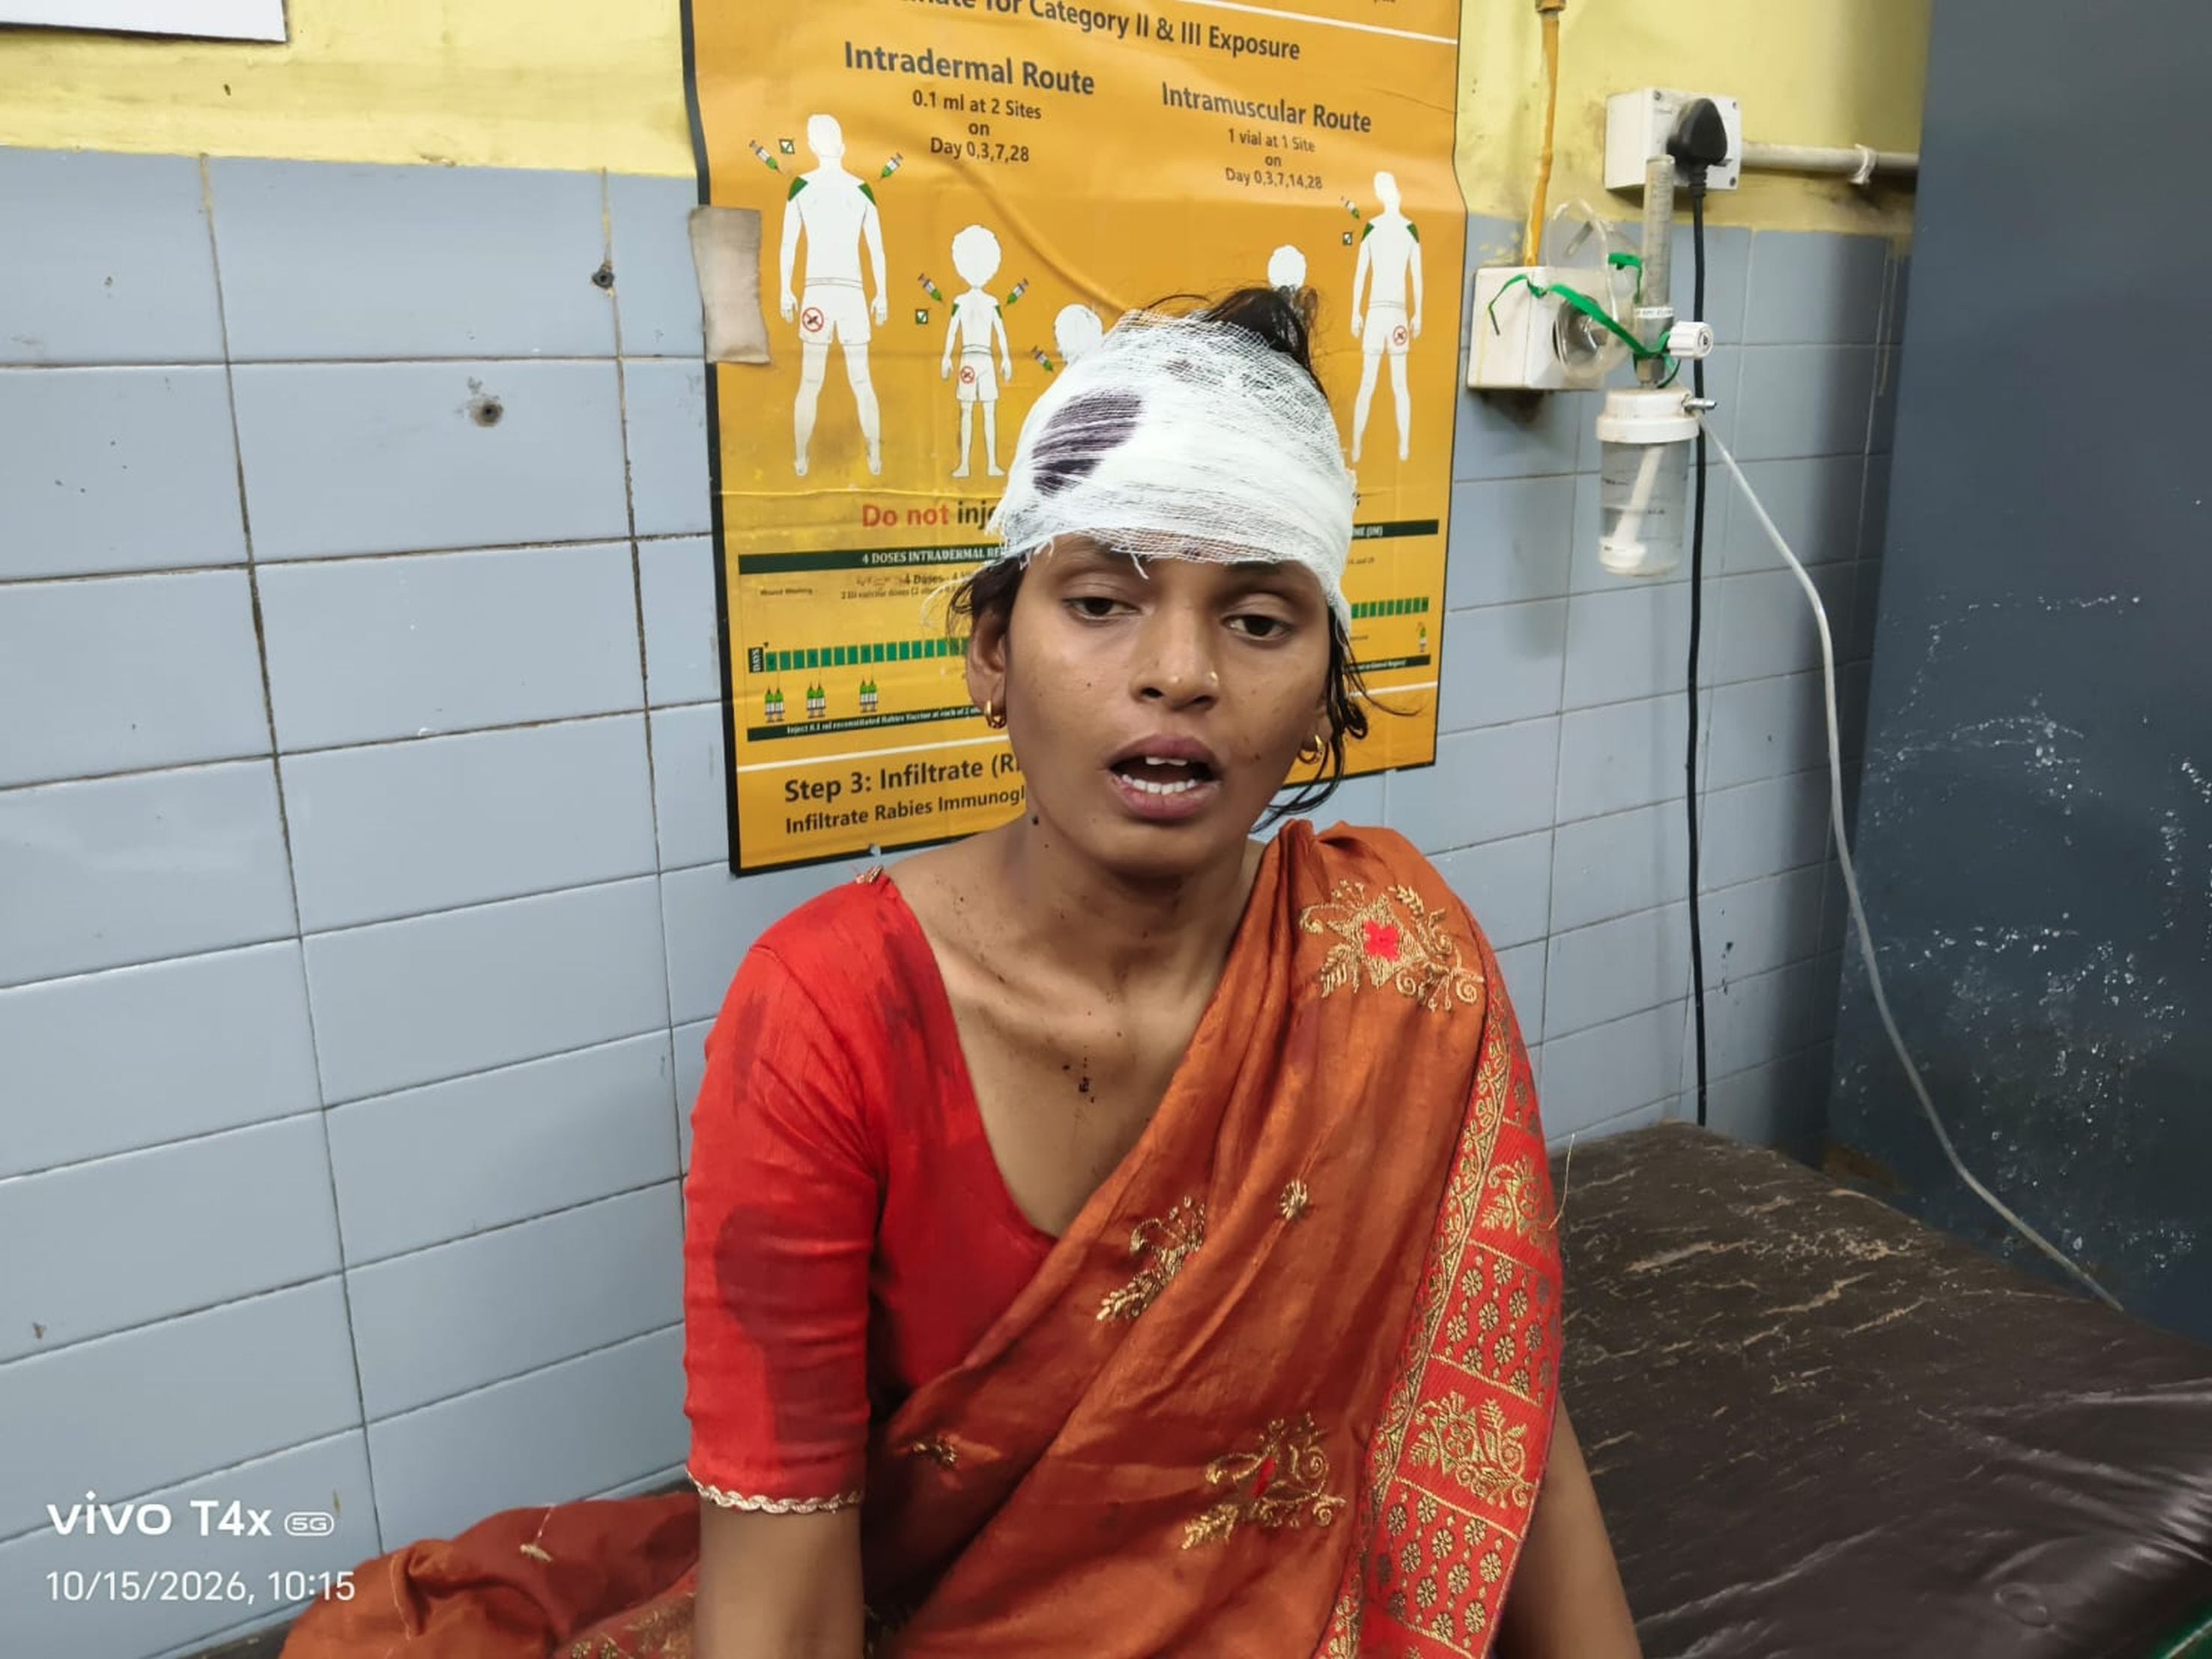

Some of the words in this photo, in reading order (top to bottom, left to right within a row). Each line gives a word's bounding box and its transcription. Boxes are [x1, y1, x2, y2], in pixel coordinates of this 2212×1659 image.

[1030, 0, 1129, 39] Category
[1136, 13, 1149, 37] II
[1156, 17, 1175, 43] &
[1181, 21, 1202, 46] III
[1208, 25, 1300, 60] Exposure
[844, 41, 1013, 85] Intradermal
[1022, 61, 1095, 95] Route
[912, 89, 936, 108] 0.1
[943, 94, 964, 111] ml
[970, 99, 987, 113] at
[991, 98, 1000, 115] 2
[1005, 100, 1042, 119] Sites
[1162, 82, 1306, 124] Intramuscular
[1313, 103, 1372, 133] Route
[968, 122, 990, 136] on
[1228, 128, 1234, 143] 1
[1240, 131, 1261, 146] vial
[1266, 136, 1279, 148] at
[1282, 135, 1288, 148] 1
[1293, 136, 1315, 152] Site
[930, 137, 962, 159] Day
[966, 141, 1029, 163] 0,3,7,28
[1265, 155, 1282, 167] on
[1225, 167, 1250, 187] Day
[1254, 170, 1323, 189] 0,3,7,14,28
[862, 504, 897, 527] Do
[907, 504, 950, 526] not
[862, 553, 869, 564] 4
[872, 551, 906, 564] DOSES
[909, 548, 984, 562] INTRADERMAL
[784, 779, 841, 804] Step
[851, 771, 872, 795] 3:
[881, 760, 983, 789] Infiltrate
[787, 809, 869, 834] Infiltrate
[875, 801, 933, 821] Rabies
[939, 785, 1025, 811] Immunogl
